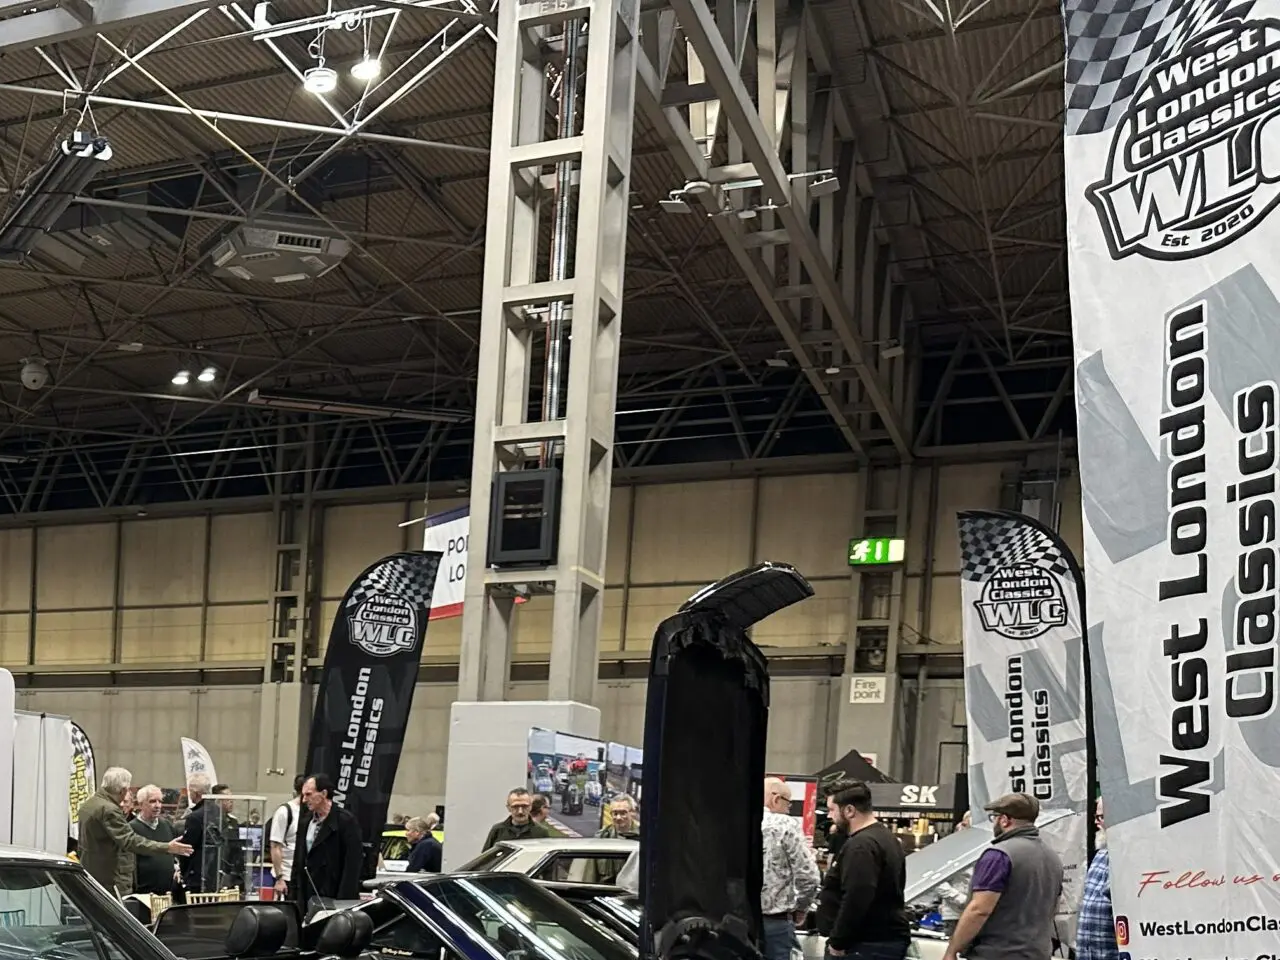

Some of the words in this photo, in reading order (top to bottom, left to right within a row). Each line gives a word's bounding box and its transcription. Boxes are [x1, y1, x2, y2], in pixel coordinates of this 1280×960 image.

[1156, 27, 1261, 94] West
[1137, 50, 1280, 135] London
[1160, 233, 1190, 247] Est
[1201, 203, 1255, 242] 2020
[1159, 302, 1208, 601] London
[1225, 384, 1276, 718] Classics
[993, 578, 1049, 589] London
[1000, 568, 1041, 578] West
[374, 595, 404, 606] West
[990, 588, 1052, 600] Classics
[362, 611, 409, 624] Classics
[366, 603, 409, 615] London
[981, 600, 1062, 627] WLC
[353, 621, 415, 646] WLC
[853, 688, 881, 700] point
[854, 678, 877, 690] Fire
[342, 667, 372, 750] London
[1005, 657, 1025, 758] London
[1159, 617, 1211, 829] West
[353, 697, 384, 788] Classics
[1031, 690, 1052, 800] Classics
[900, 784, 939, 804] SK
[1137, 870, 1226, 898] Follow
[1233, 873, 1265, 886] us
[1139, 915, 1280, 937] WestLondonCla
